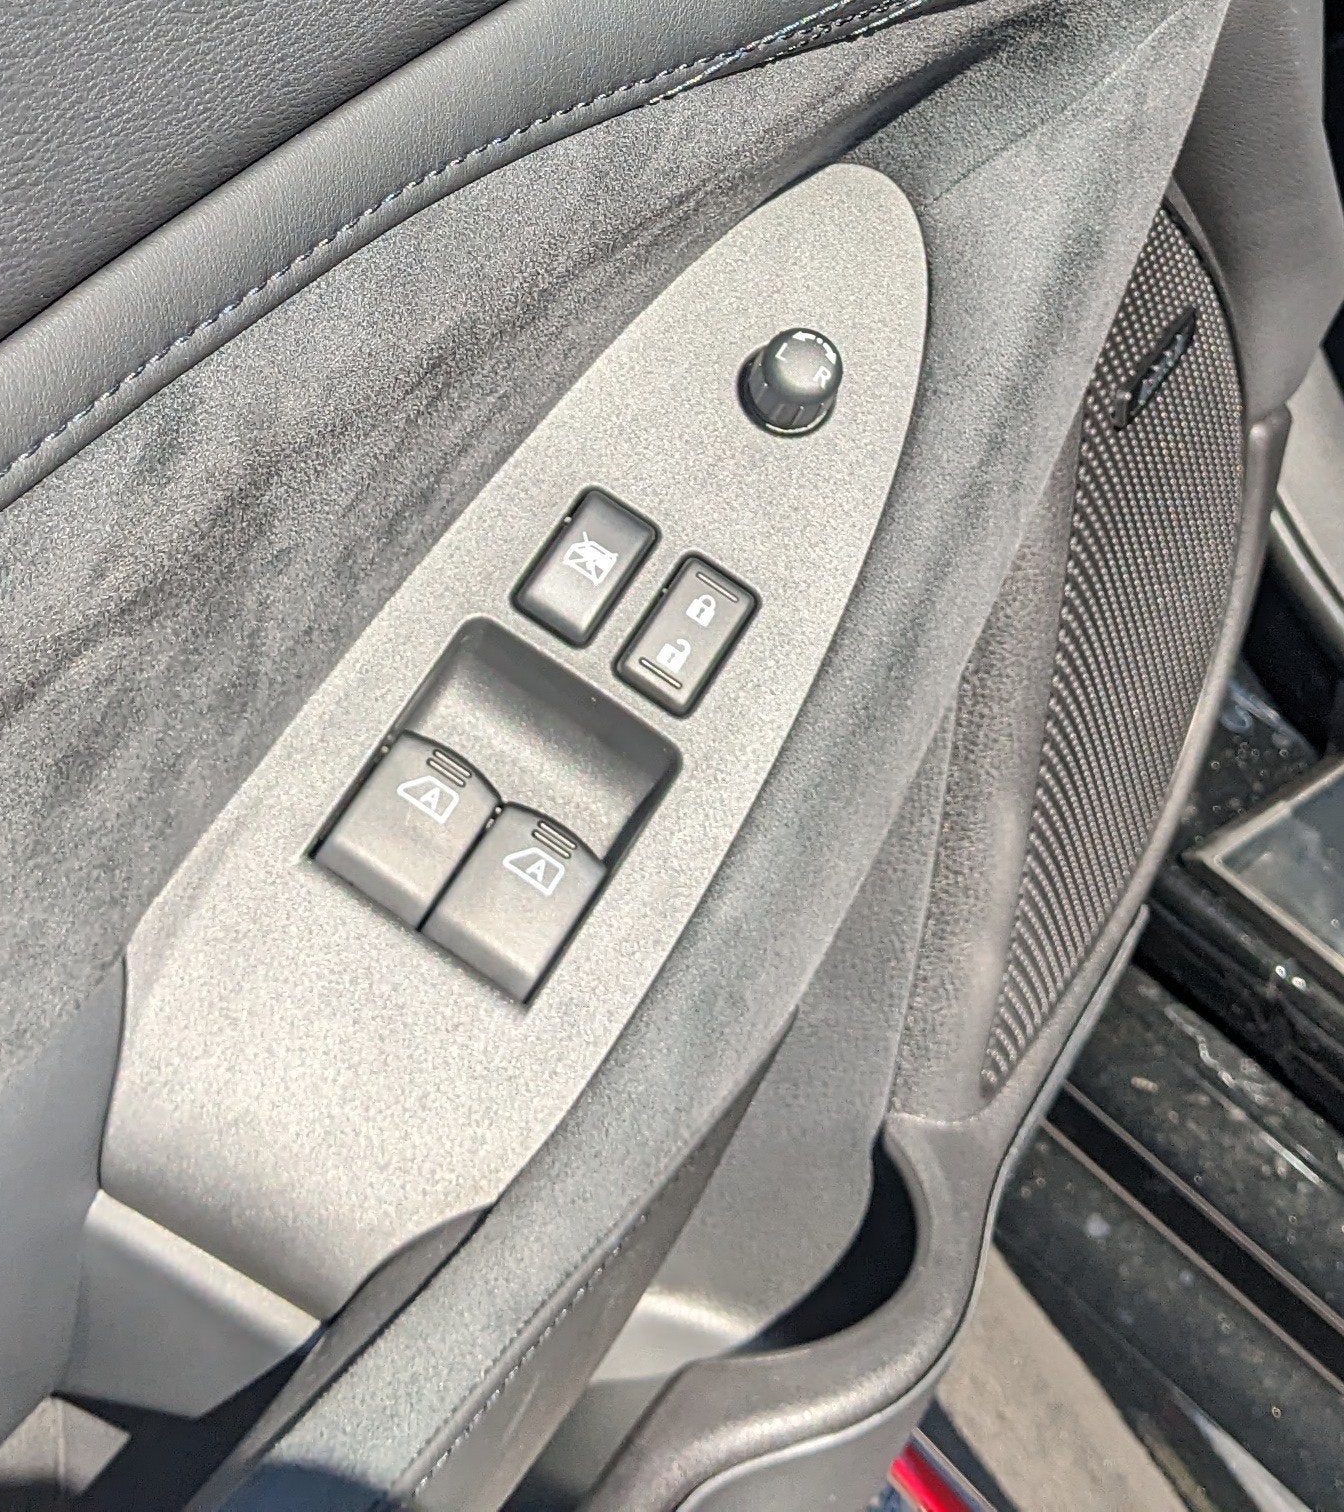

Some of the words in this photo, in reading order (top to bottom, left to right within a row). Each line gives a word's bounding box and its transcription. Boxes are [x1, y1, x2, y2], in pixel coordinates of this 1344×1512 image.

[775, 342, 788, 362] L
[813, 366, 832, 389] R
[420, 787, 441, 810] A
[526, 858, 546, 882] A
